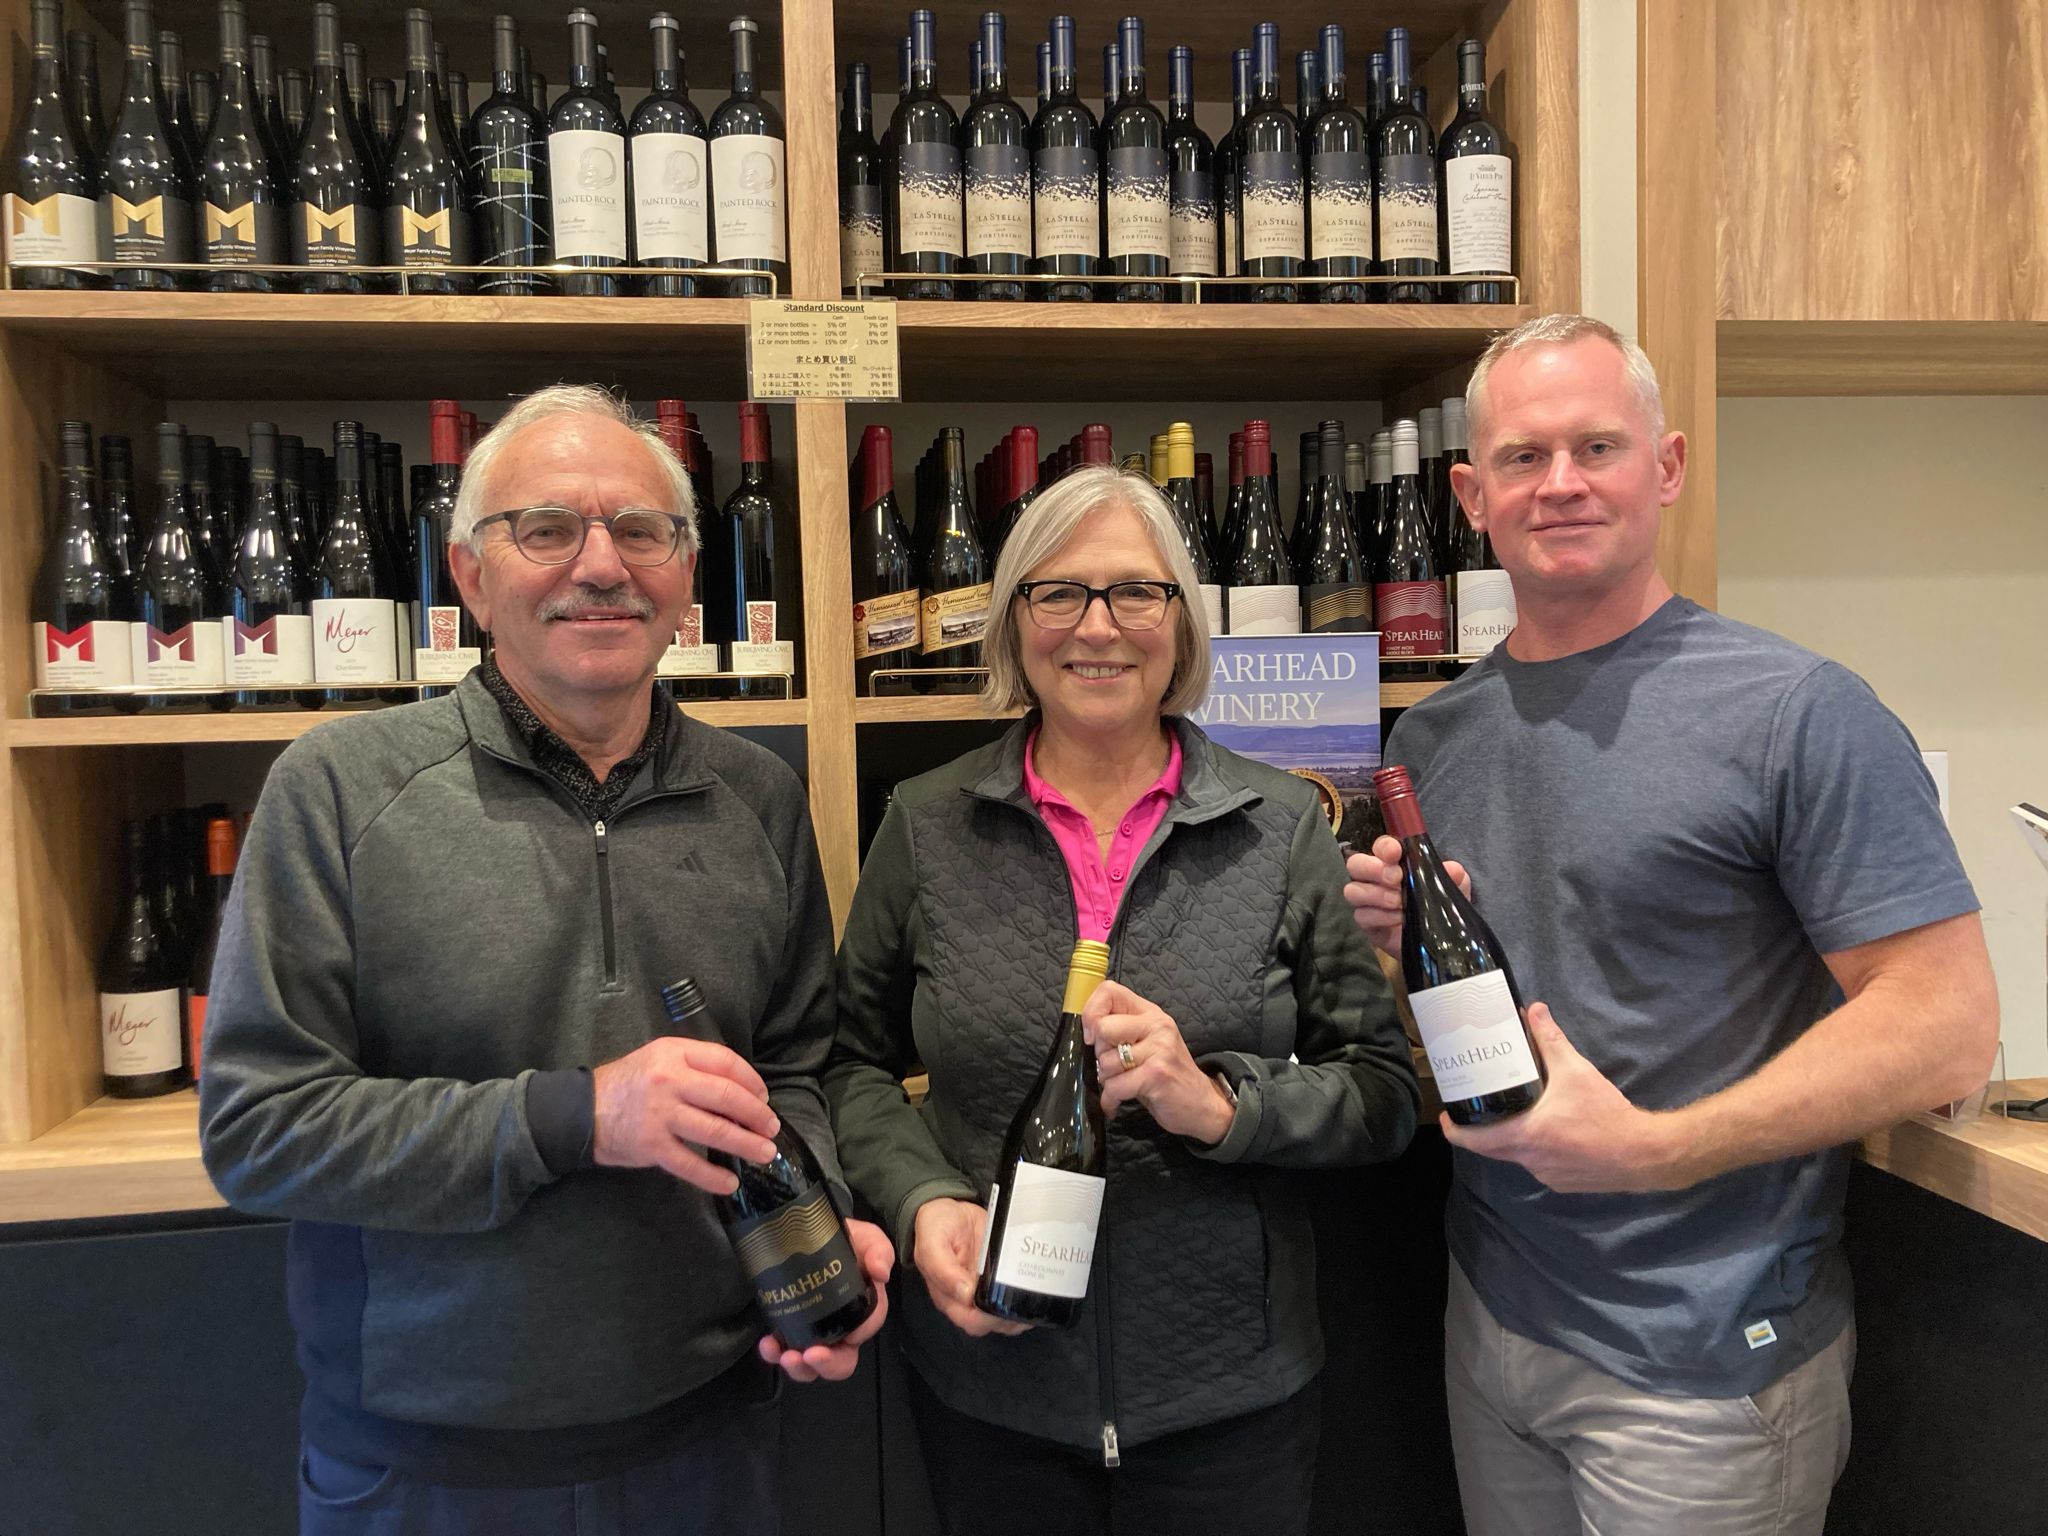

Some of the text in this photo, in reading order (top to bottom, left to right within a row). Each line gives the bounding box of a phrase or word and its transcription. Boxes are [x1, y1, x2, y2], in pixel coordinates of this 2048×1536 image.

[558, 194, 617, 205] PAINTED ROCK
[642, 197, 700, 208] PAINTED ROCK
[720, 199, 777, 209] PAINTED ROCK
[784, 303, 865, 313] Standard Discount
[796, 355, 857, 365] まとめ買い割引
[1210, 652, 1357, 683] ARHEAD
[1432, 1041, 1513, 1072] SPEARHEAD
[1022, 1235, 1093, 1265] SPEARHEA
